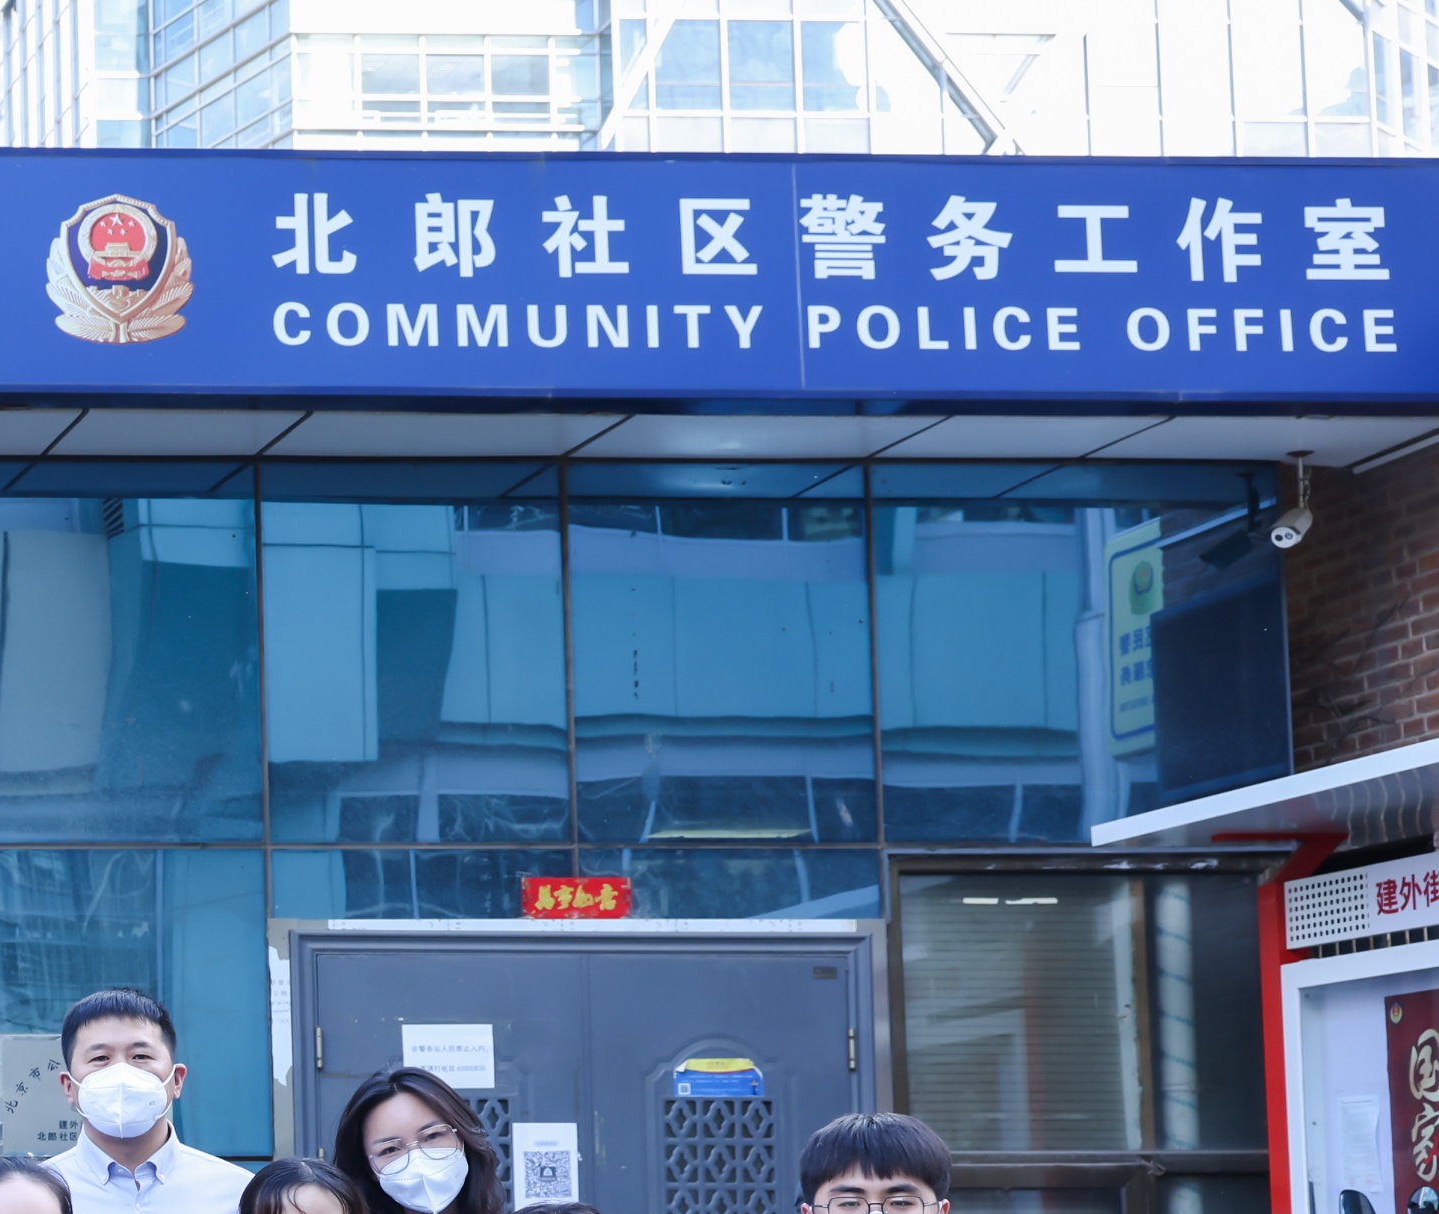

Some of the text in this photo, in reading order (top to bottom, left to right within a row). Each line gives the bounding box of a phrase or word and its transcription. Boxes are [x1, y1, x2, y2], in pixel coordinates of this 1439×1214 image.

[272, 192, 1390, 283] 北郎社区警务工作室
[273, 302, 1398, 353] COMMUNITY POLICE OFFICE
